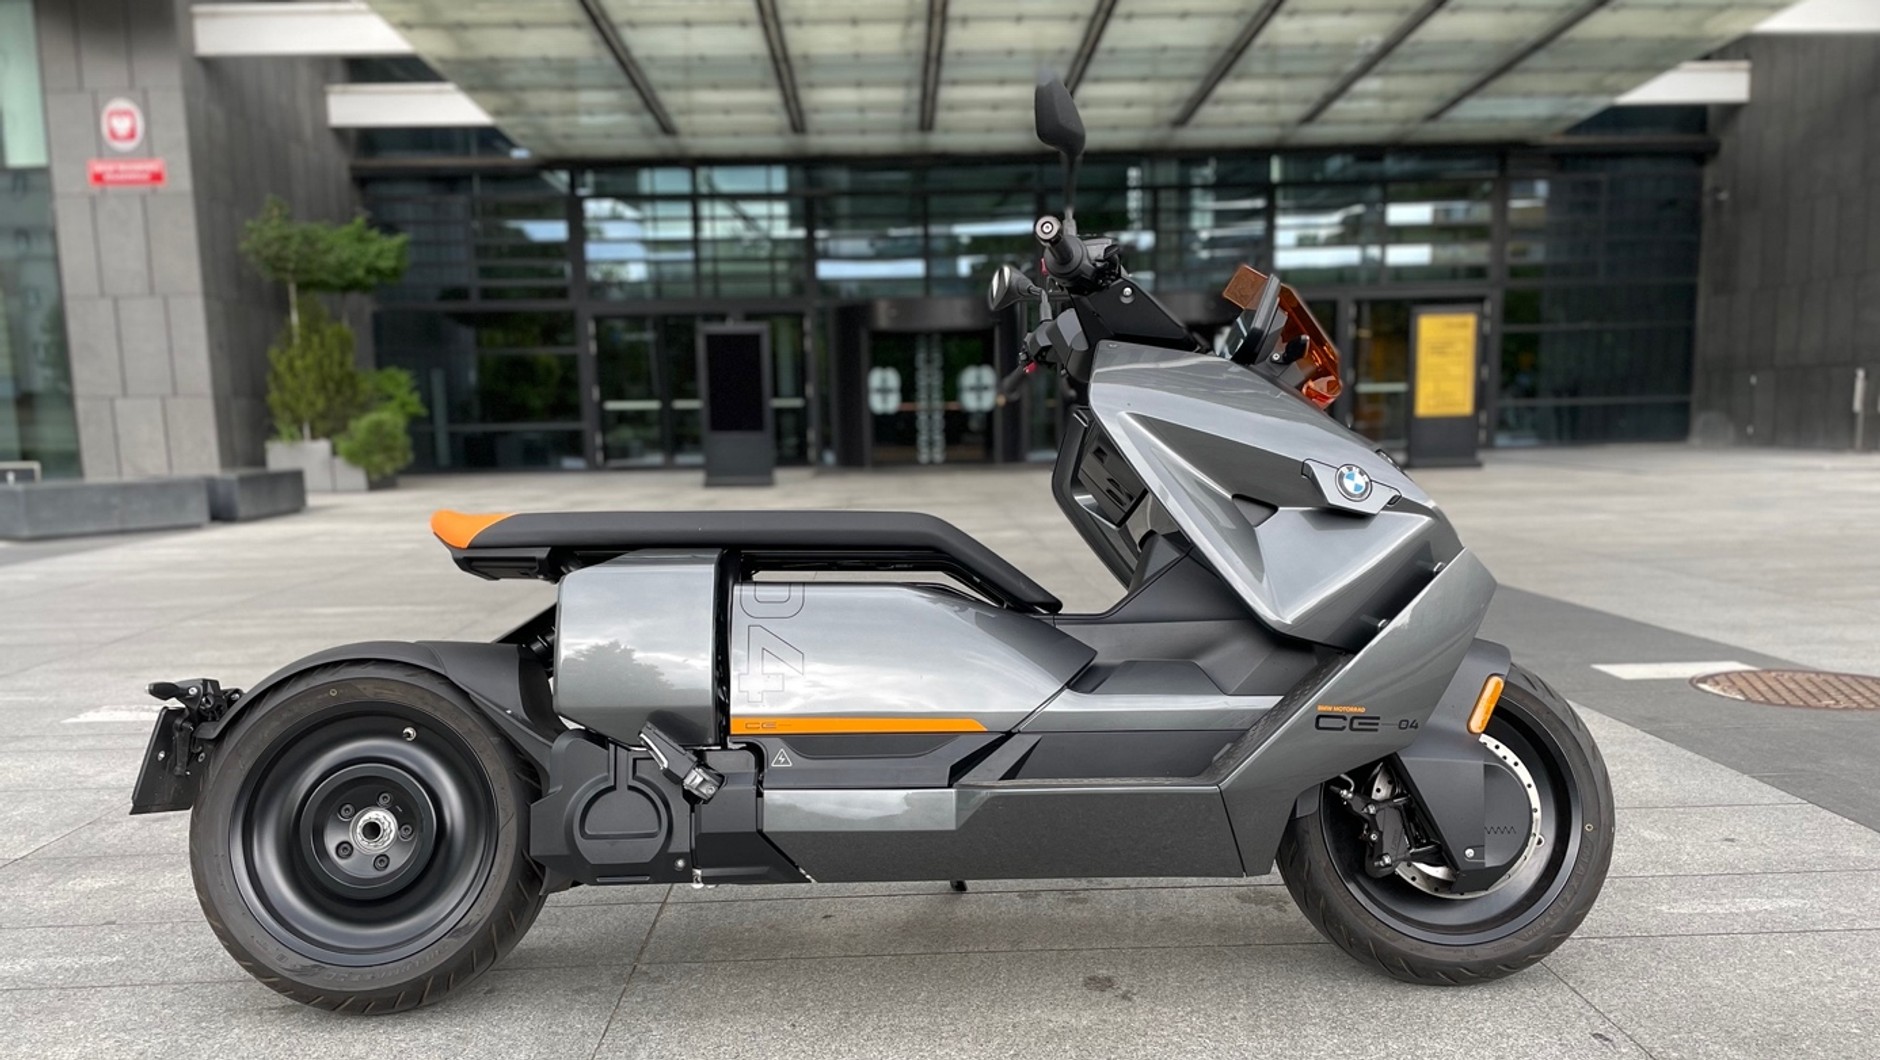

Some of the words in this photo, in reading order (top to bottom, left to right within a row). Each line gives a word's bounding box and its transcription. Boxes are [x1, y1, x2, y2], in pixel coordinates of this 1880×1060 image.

[1333, 705, 1366, 713] MOTORRAD
[745, 722, 777, 730] CE
[1314, 714, 1381, 732] CE
[1397, 719, 1419, 730] 04
